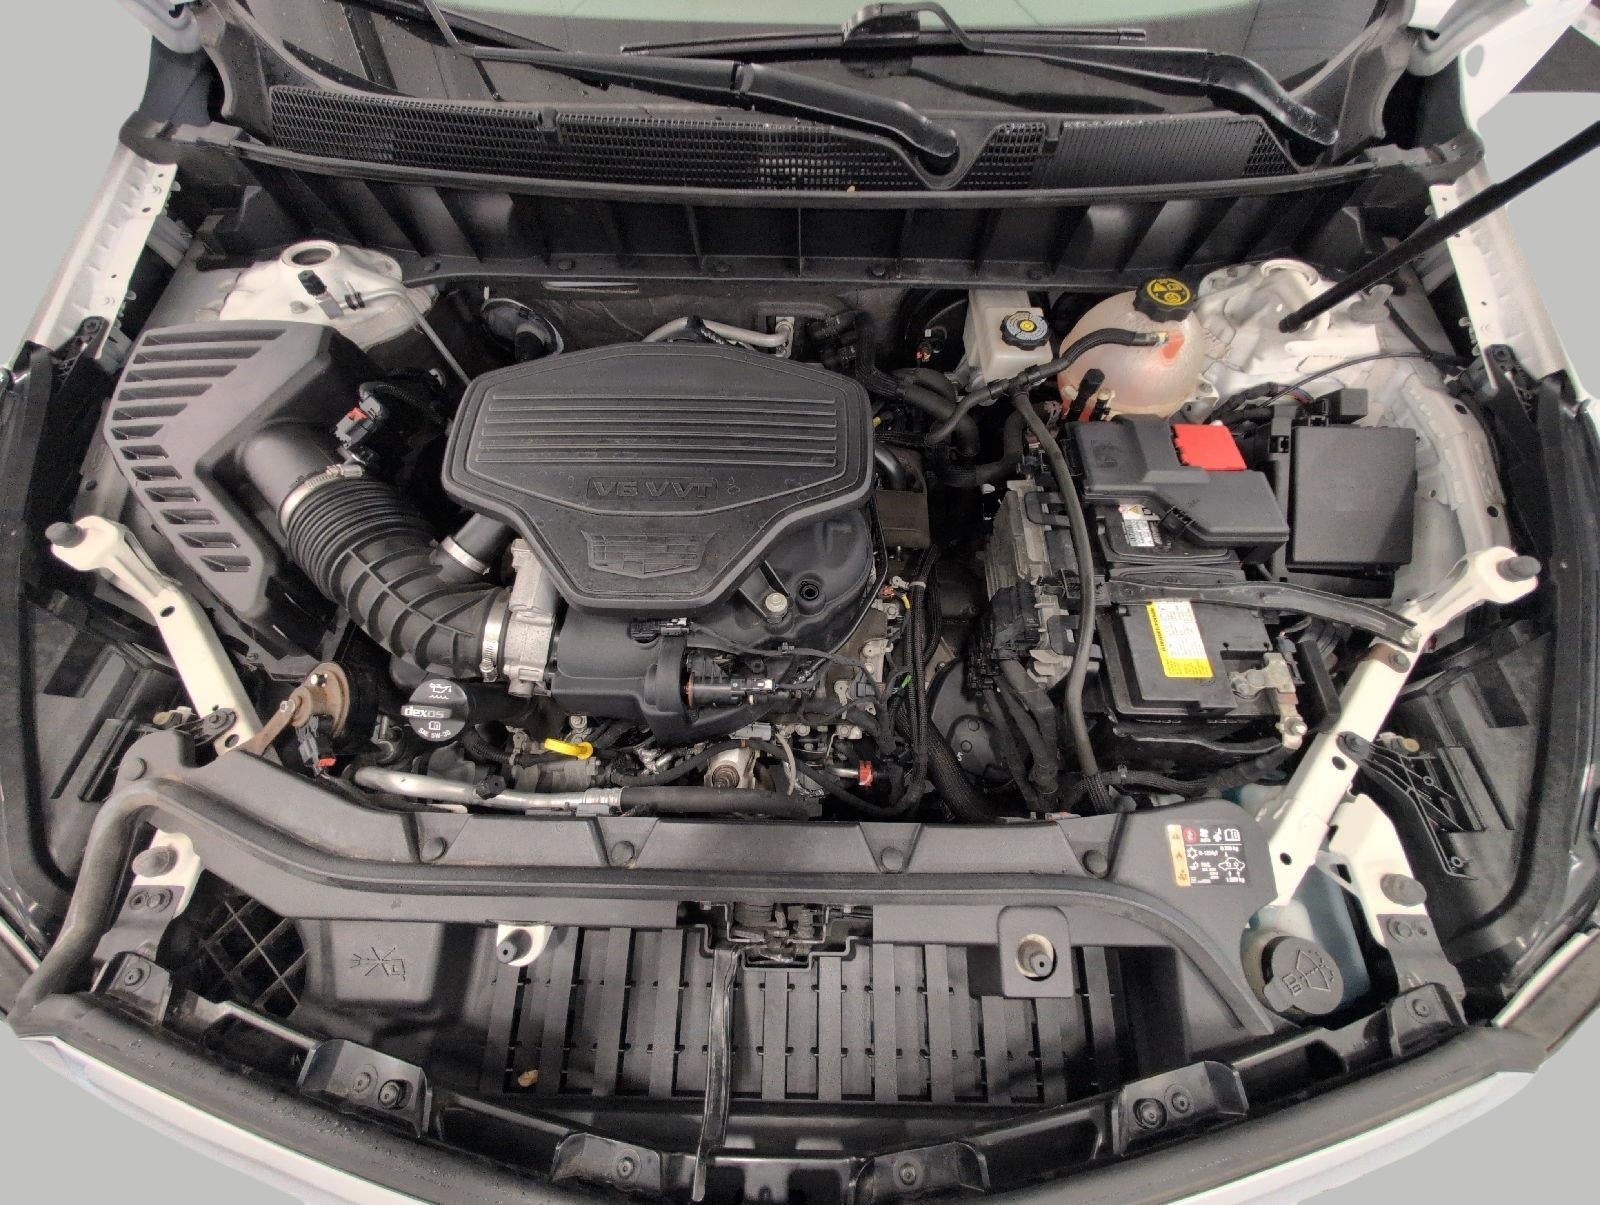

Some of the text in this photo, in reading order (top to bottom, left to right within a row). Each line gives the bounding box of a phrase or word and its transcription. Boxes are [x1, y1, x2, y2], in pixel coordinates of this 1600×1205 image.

[593, 481, 713, 498] V6 VVT
[404, 706, 445, 718] dexos
